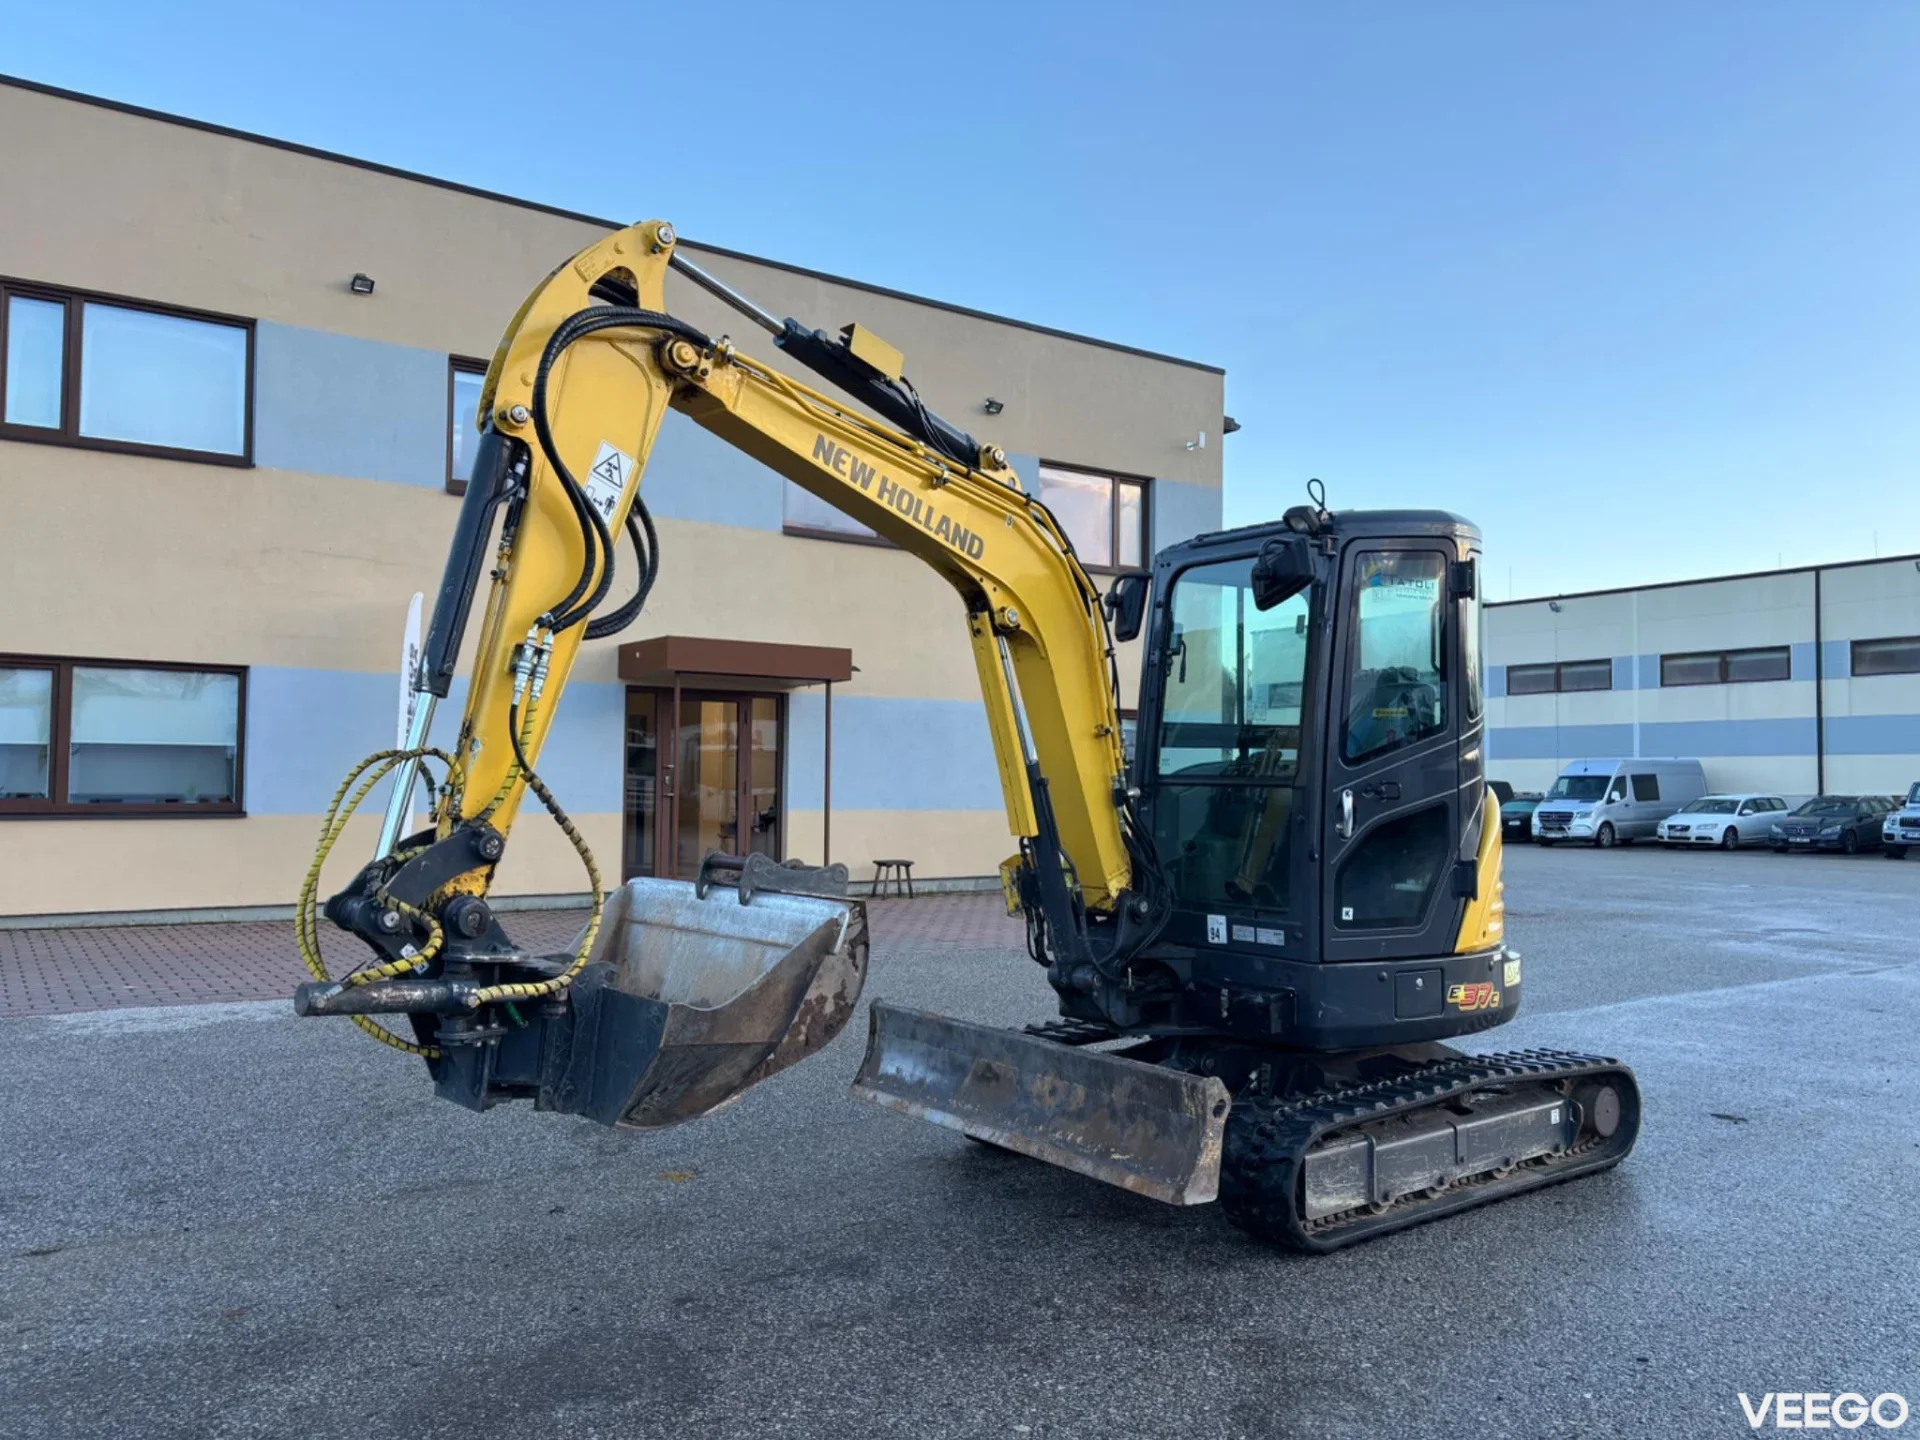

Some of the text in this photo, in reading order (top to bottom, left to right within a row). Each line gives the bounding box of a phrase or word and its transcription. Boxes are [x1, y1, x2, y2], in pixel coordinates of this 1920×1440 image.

[812, 433, 984, 560] NEW HOLLAND
[1210, 926, 1221, 941] 94
